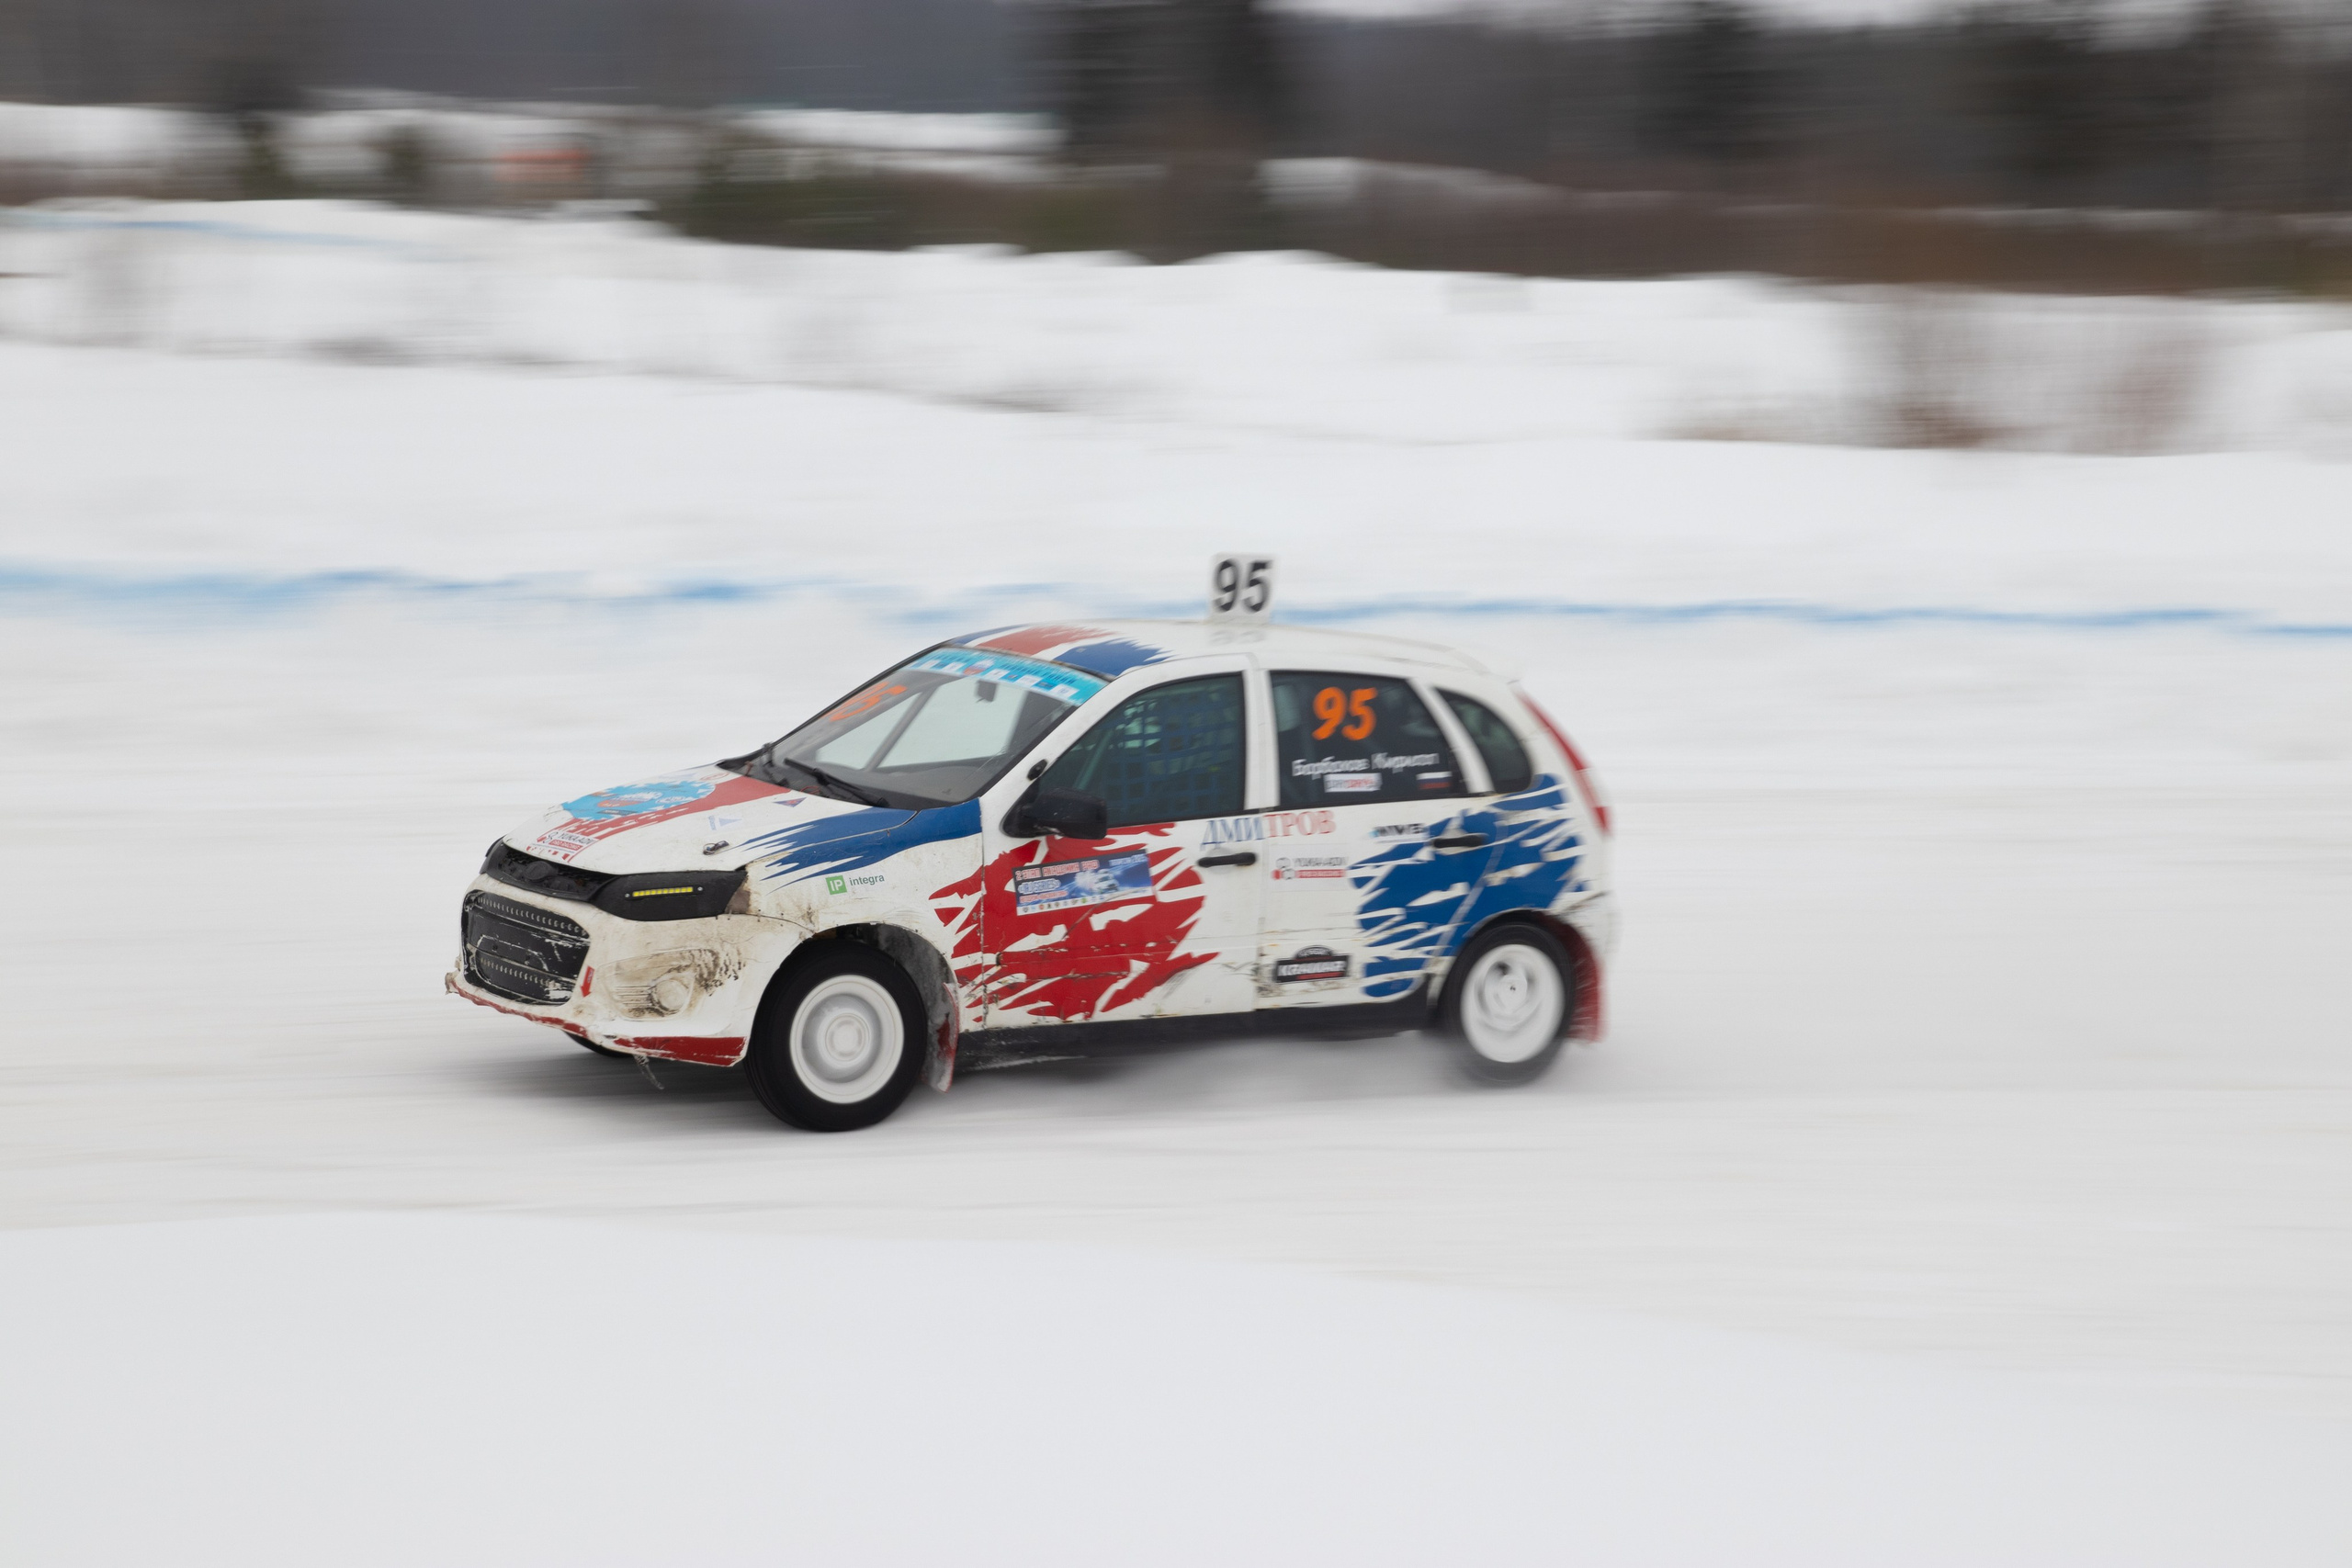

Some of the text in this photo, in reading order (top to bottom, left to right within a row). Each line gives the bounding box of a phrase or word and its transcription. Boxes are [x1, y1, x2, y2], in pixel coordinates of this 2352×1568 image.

[1213, 558, 1273, 614] 95
[1312, 686, 1377, 740] 95
[1200, 810, 1336, 851] ДМИТРОВ
[830, 874, 885, 892] IP integra
